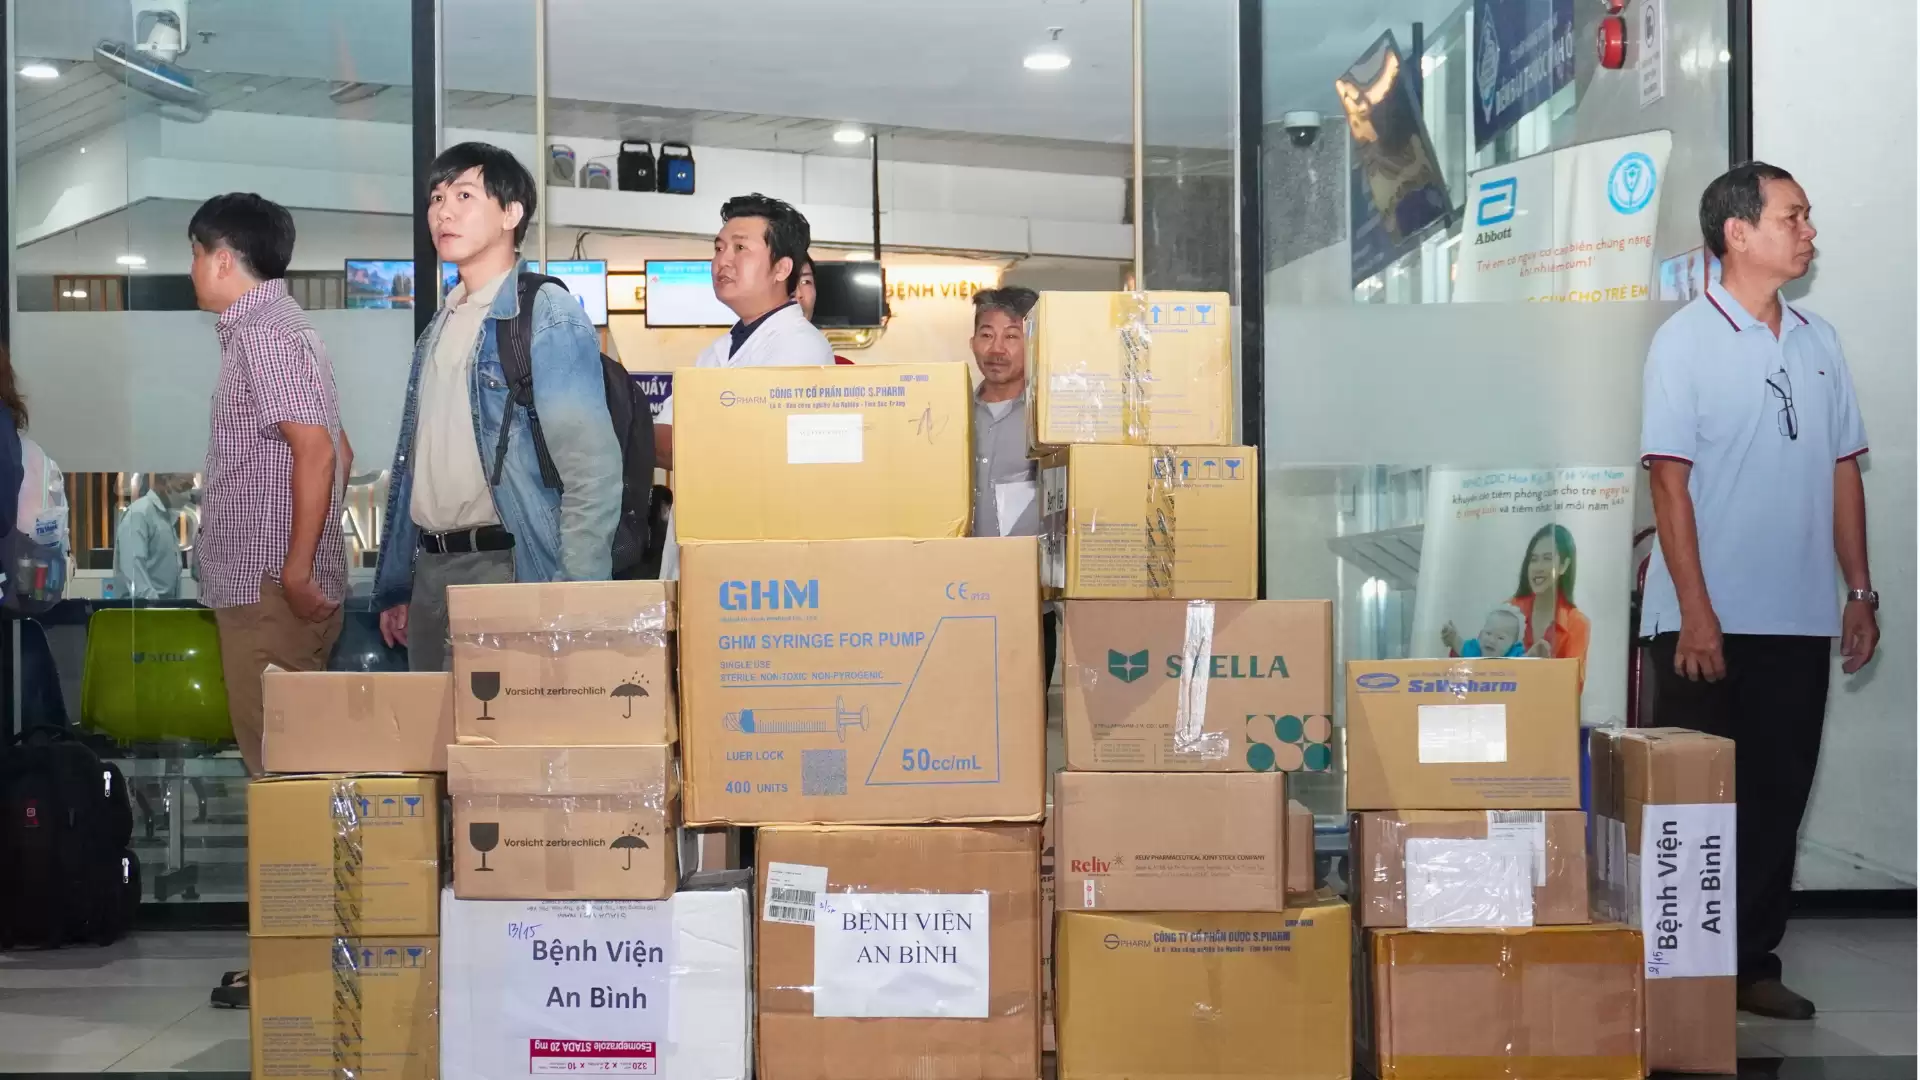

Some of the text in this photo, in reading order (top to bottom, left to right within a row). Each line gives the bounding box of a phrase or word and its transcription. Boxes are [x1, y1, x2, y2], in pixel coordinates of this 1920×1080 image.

[1475, 228, 1512, 245] Abbott
[1631, 285, 1649, 297] EM
[769, 386, 792, 399] CÔNG
[794, 387, 804, 398] TY
[868, 386, 906, 397] S.PHARM
[1561, 484, 1578, 495] cho
[719, 579, 819, 611] GHM
[718, 631, 925, 650] GHM SYRINGE FOR PUMP
[720, 659, 771, 670] SINGLE USE
[1165, 654, 1290, 678] SELLA
[760, 672, 808, 681] NON-TOXIC
[811, 670, 884, 681] NON-PYROGENIC
[505, 686, 606, 696] Vorsicht zerbrechlich
[726, 751, 784, 761] LUER LOCK
[725, 781, 788, 794] 400 UNITS
[504, 838, 606, 847] Vorsicht zerbrechlich
[1071, 856, 1111, 873] Reliv
[1656, 820, 1683, 950] Bệnh Viện
[1700, 834, 1721, 935] An Bình
[842, 909, 973, 935] BỆNH VIỆN
[1153, 930, 1177, 943] CÔNG
[1179, 932, 1189, 943] TY
[532, 939, 664, 967] Bệnh Viện
[857, 940, 957, 964] AN BÌNH
[545, 986, 647, 1009] An Bình
[534, 1039, 652, 1053] Esomeprazole STADA 20 mg
[567, 1062, 577, 1070] 10
[604, 1062, 610, 1070] 2
[632, 1062, 648, 1070] 320
